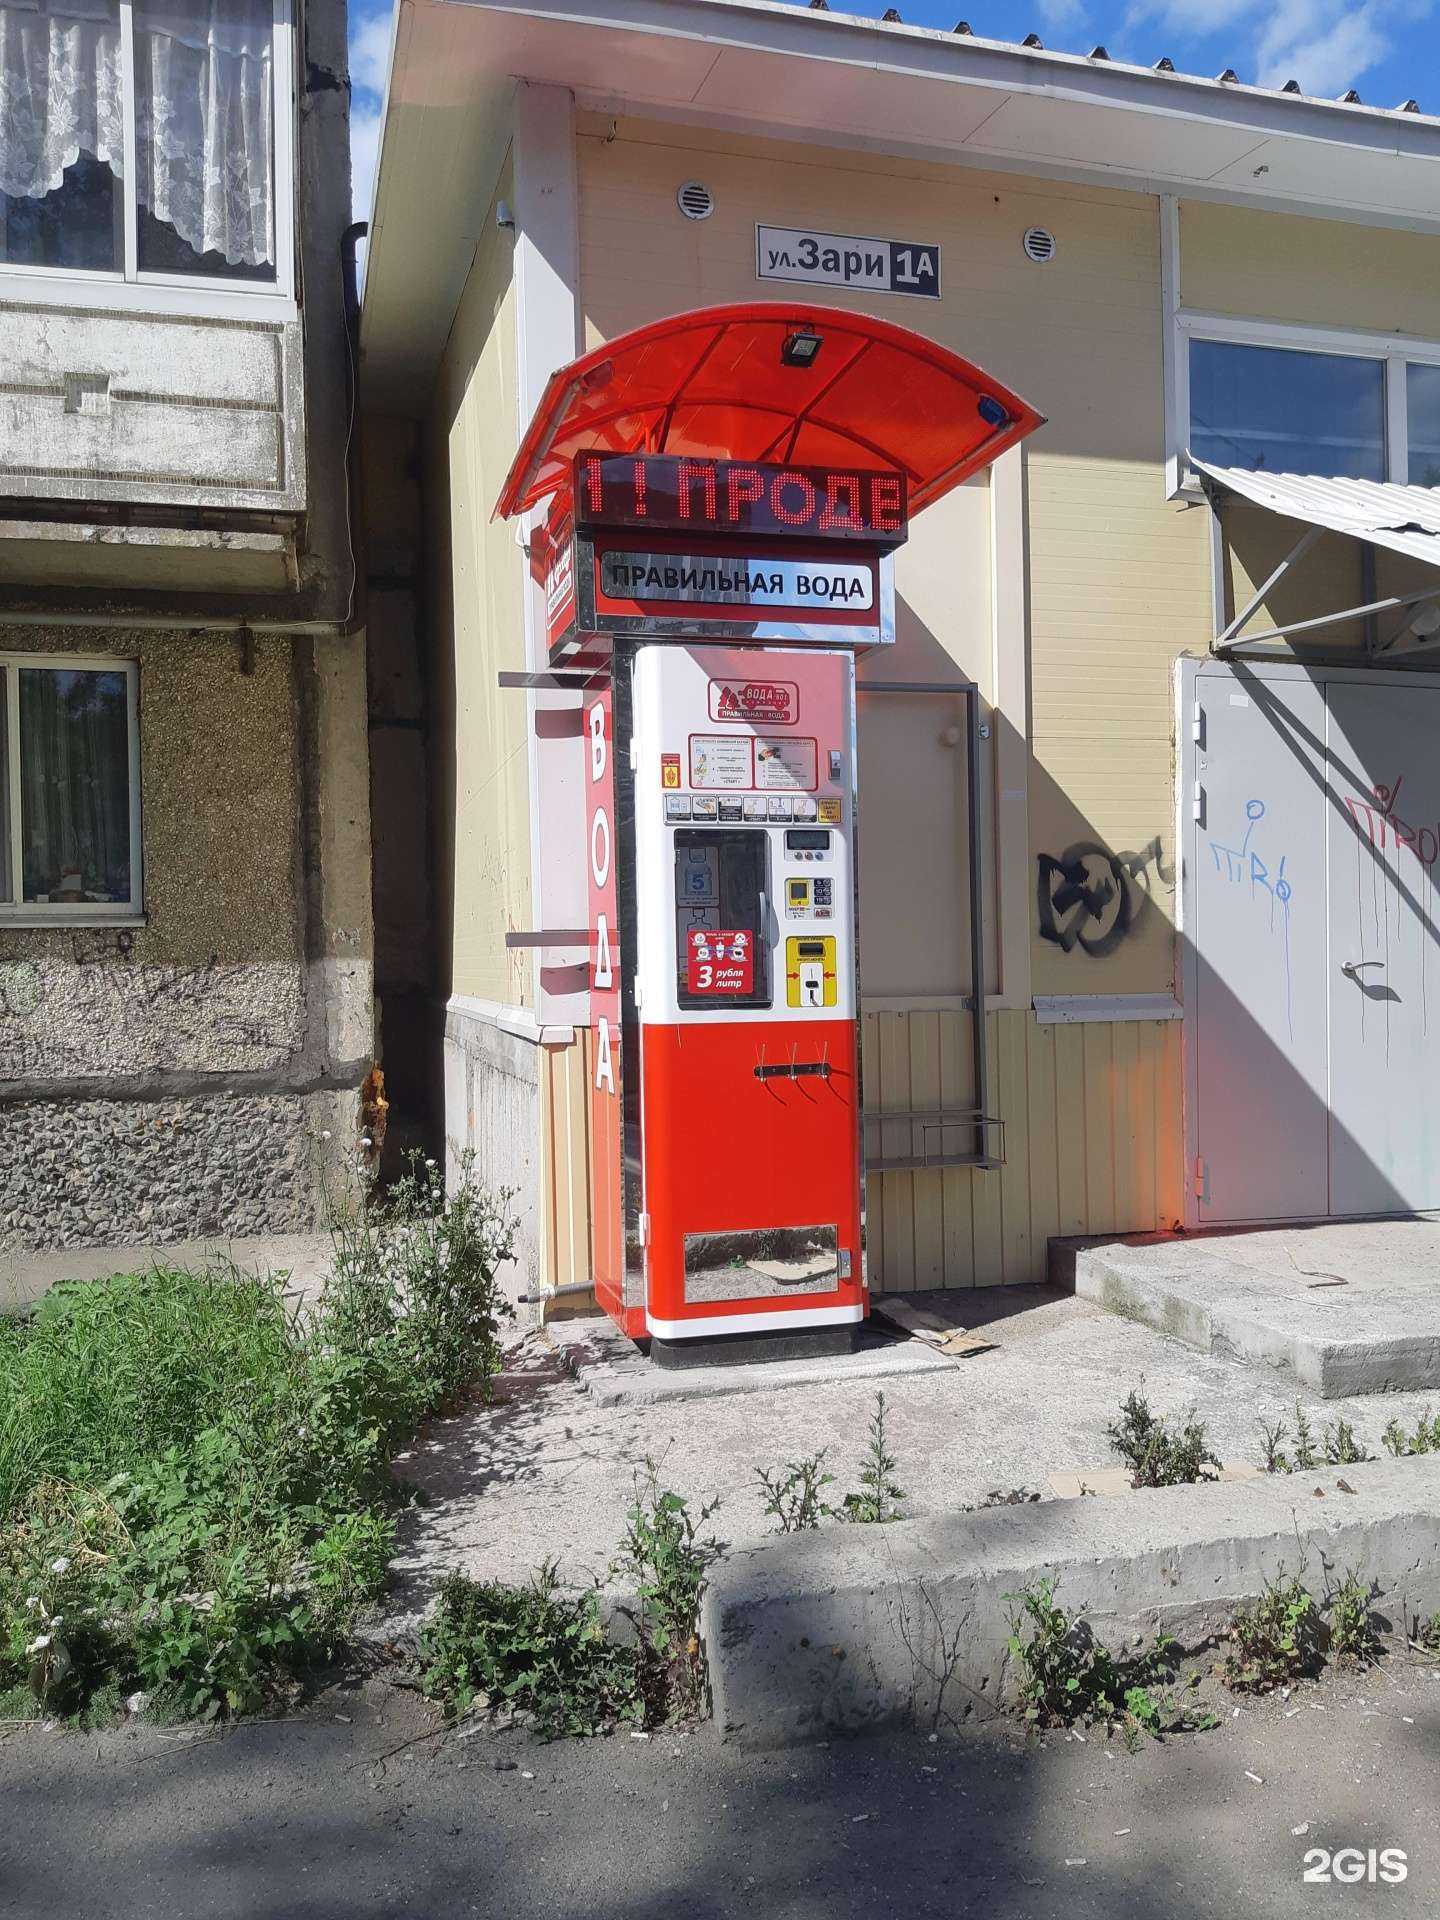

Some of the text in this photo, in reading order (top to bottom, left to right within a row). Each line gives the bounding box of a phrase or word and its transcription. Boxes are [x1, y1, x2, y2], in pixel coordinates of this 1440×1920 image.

[896, 250, 934, 284] 1А
[612, 564, 865, 602] ПРАВИЛЬНАЯ ВОДА
[746, 687, 774, 700] ВОДА
[692, 873, 705, 890] 5
[589, 701, 615, 1095] ВОДА
[696, 965, 744, 988] 3 рубля
[716, 980, 742, 988] литр
